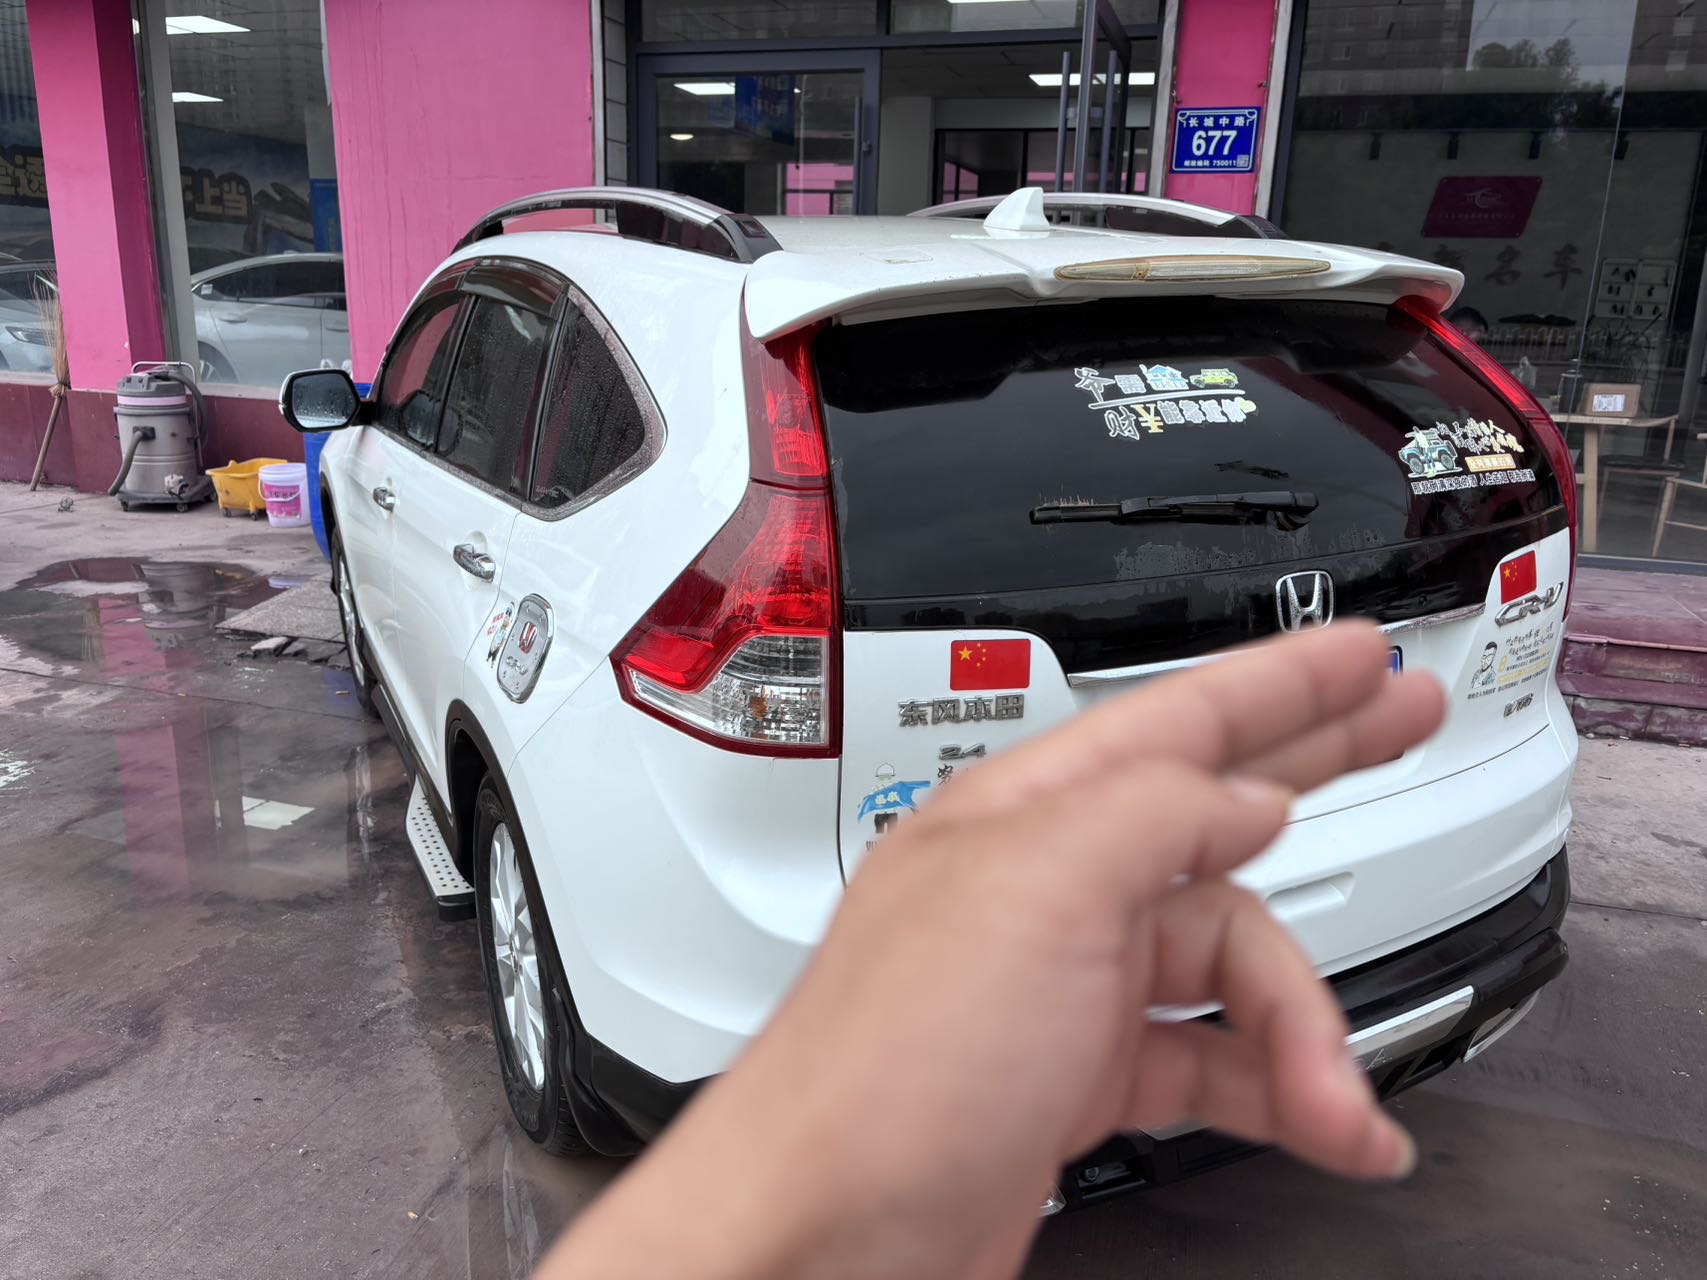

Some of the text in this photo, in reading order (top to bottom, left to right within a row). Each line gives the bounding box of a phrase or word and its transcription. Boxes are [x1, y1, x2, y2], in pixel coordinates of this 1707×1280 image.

[1188, 116, 1245, 127] 长城中路
[1192, 130, 1237, 156] 677
[898, 692, 1025, 727] 东风本田
[938, 743, 986, 760] 2.4
